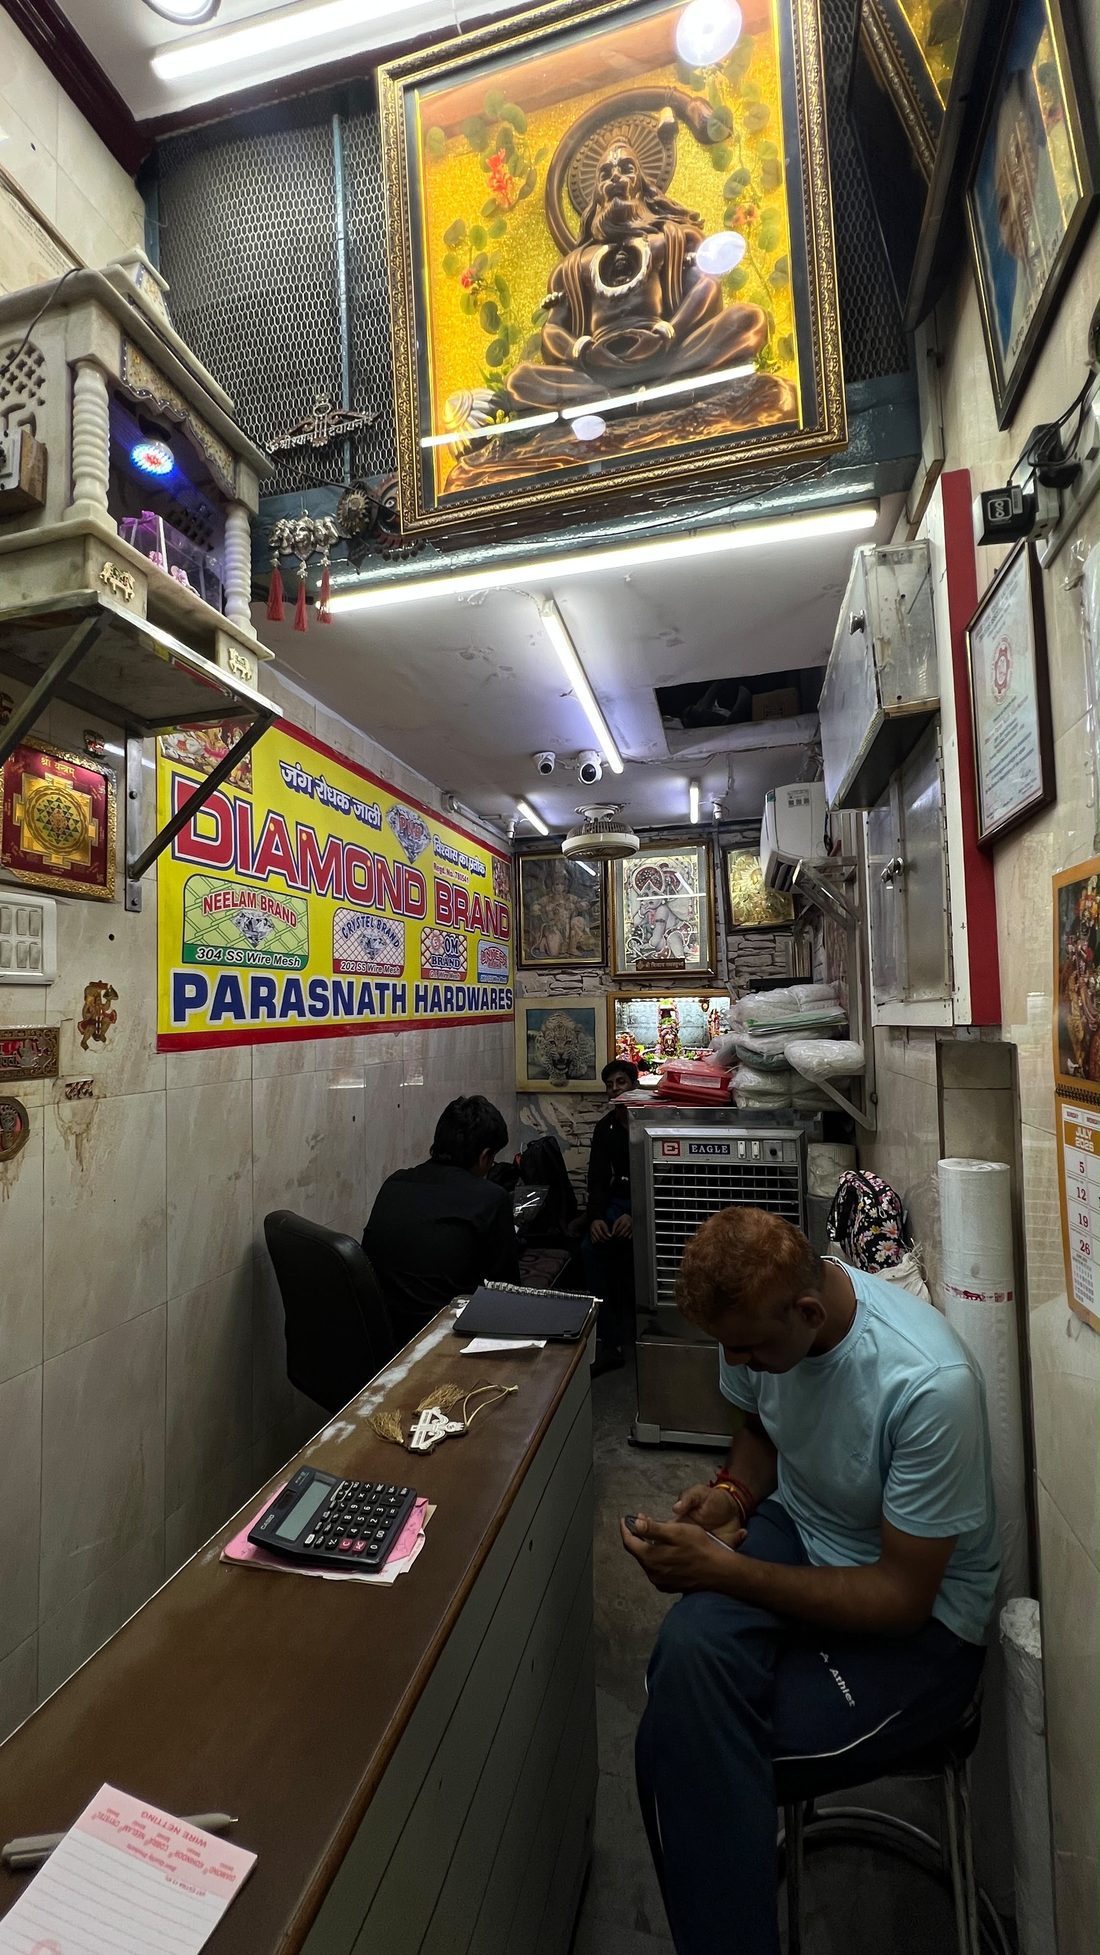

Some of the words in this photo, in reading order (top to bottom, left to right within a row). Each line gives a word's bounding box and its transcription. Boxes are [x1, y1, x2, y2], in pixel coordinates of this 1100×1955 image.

[279, 760, 314, 796] जंग
[315, 774, 351, 811] रोधक
[351, 796, 382, 829] जाली
[172, 772, 427, 920] DIAMOND
[434, 877, 510, 941] BRAND
[203, 891, 257, 915] NEELAM
[260, 894, 297, 928] BRAND
[341, 915, 374, 939] CRYSTEL
[376, 919, 400, 948] BRAND
[444, 934, 460, 955] OM
[197, 948, 222, 961] 304
[226, 951, 243, 963] SS
[246, 952, 271, 965] Wire
[273, 955, 301, 968] Mesh
[431, 954, 461, 970] BRAND
[341, 961, 356, 971] 202
[357, 963, 367, 972] SS
[368, 963, 382, 973] Wire
[384, 966, 400, 974] Mesh
[173, 972, 407, 1023] PARASNATH
[414, 983, 513, 1014] HARDWARES
[1075, 1127, 1092, 1140] JULY
[691, 1144, 729, 1153] EAGLE
[1079, 1161, 1085, 1174] 5
[1077, 1186, 1087, 1201] 12
[1078, 1213, 1089, 1228] 19
[1080, 1239, 1091, 1256] 26
[141, 1811, 180, 1835] NETTING
[182, 1830, 207, 1848] WIRE
